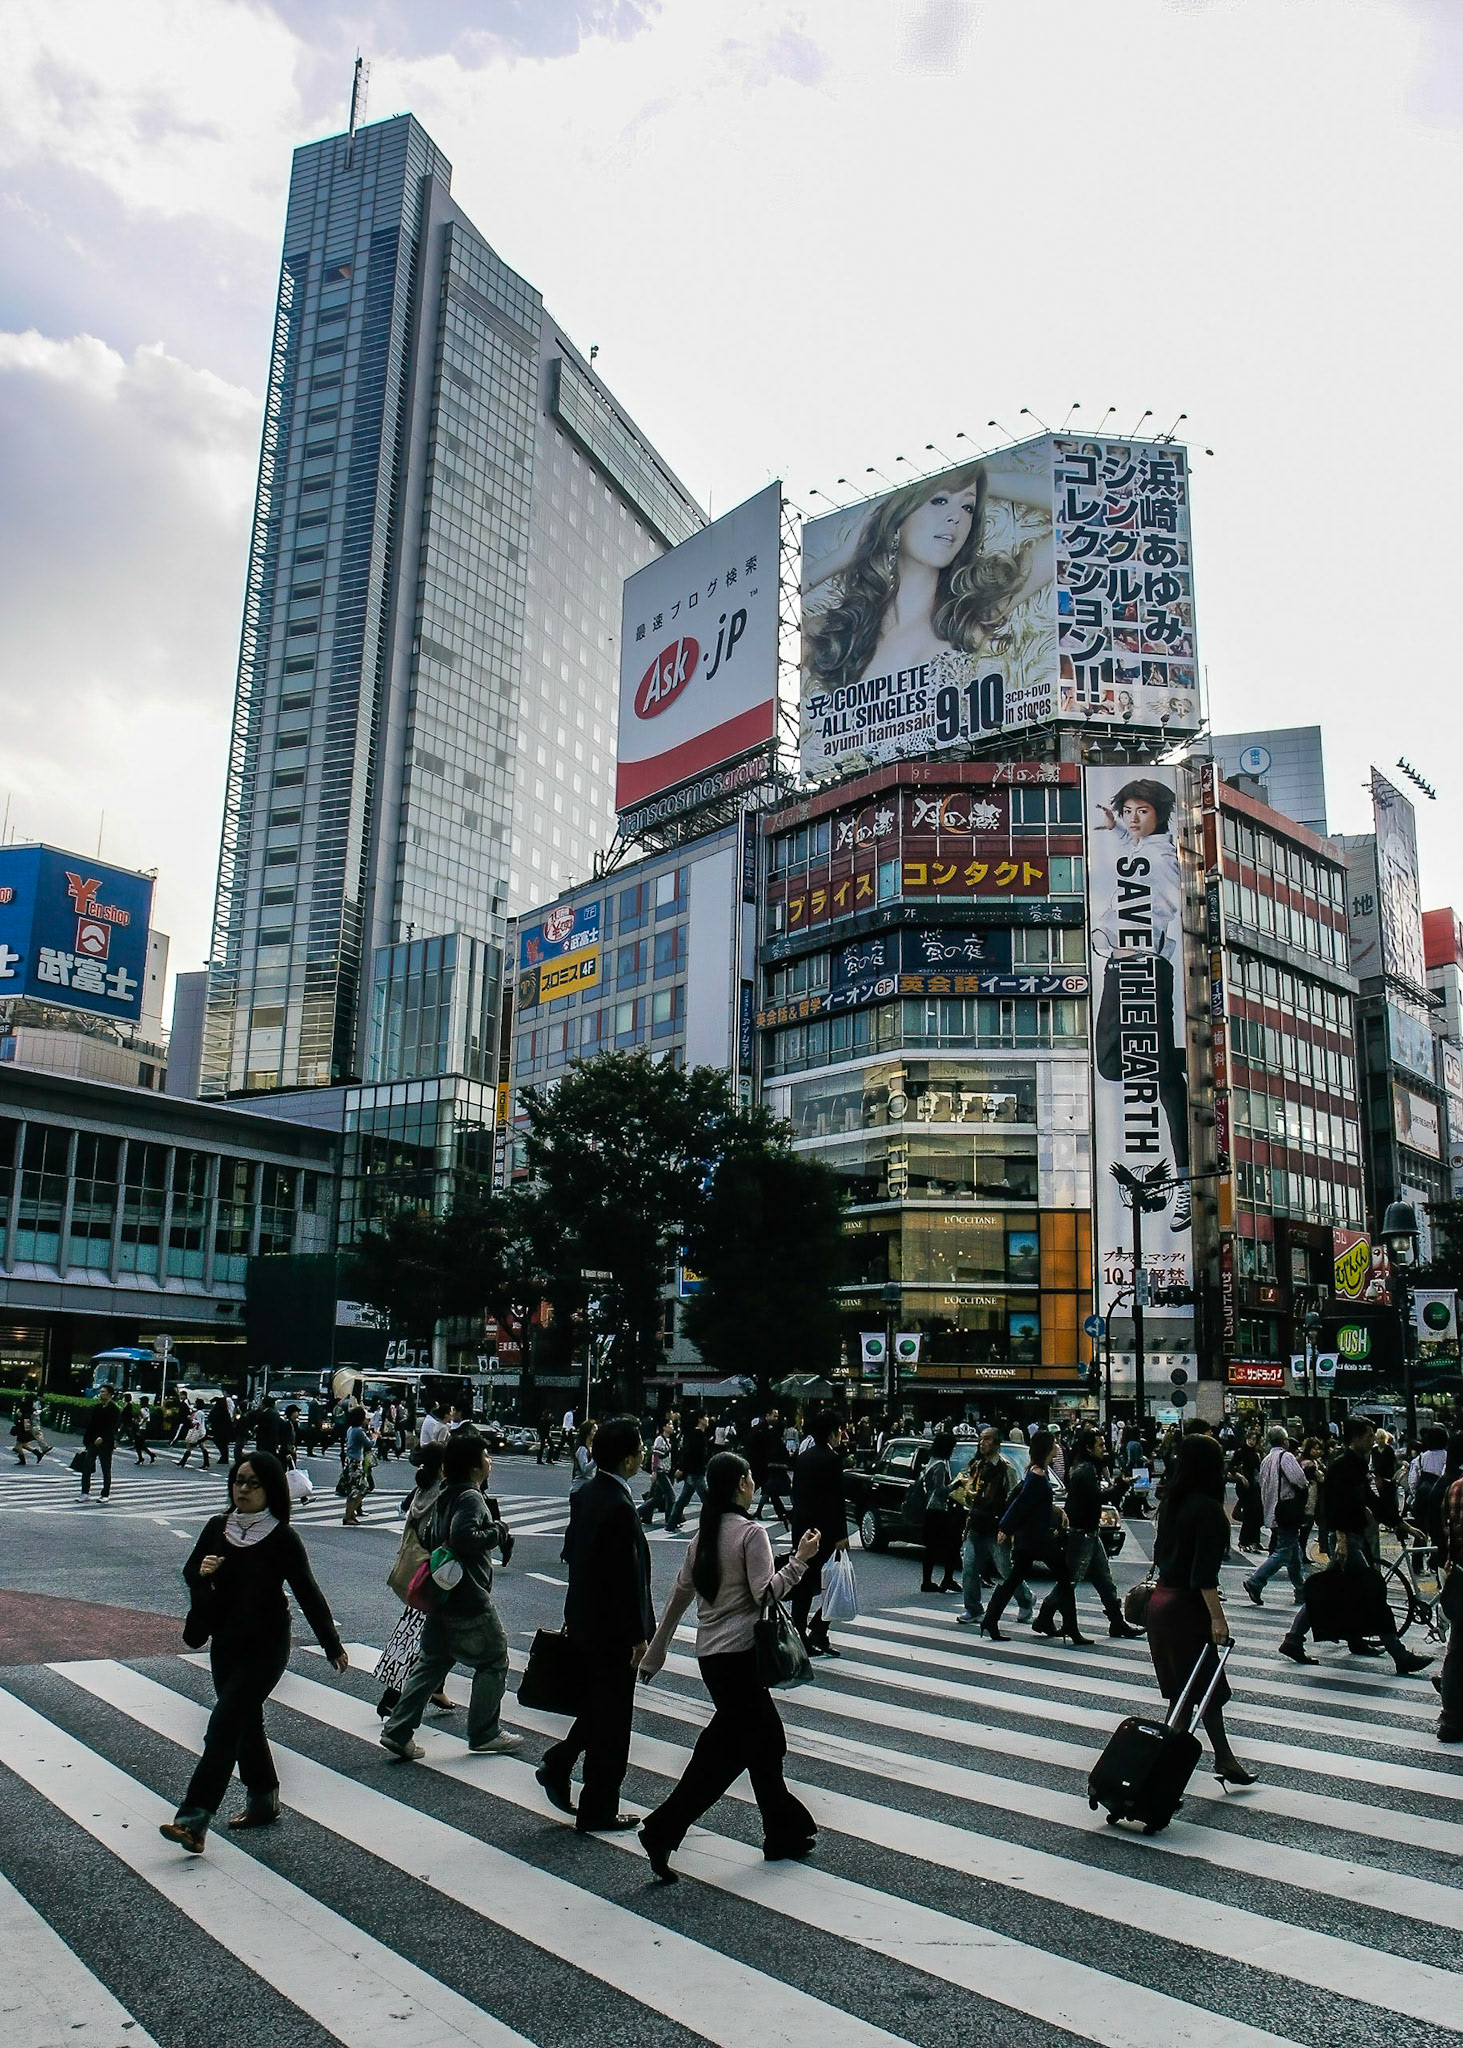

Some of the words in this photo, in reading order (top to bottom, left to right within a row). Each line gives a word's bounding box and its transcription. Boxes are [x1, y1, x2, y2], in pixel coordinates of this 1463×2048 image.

[1102, 456, 1143, 603] シングル
[636, 555, 757, 642] 最速ブログ検索
[833, 663, 930, 712] COMPLETE
[1005, 682, 1050, 704] 3CD+DVD
[1005, 706, 1014, 725] in
[823, 732, 864, 756] ayumi
[868, 710, 936, 743] hamasaki
[904, 860, 1043, 886] コンタクト
[789, 873, 873, 923] プライス
[1116, 855, 1152, 948] SAVE
[104, 905, 130, 926] shop
[904, 909, 916, 918] 7F
[37, 946, 138, 1001] 武富士
[541, 964, 578, 992] プロミス
[582, 960, 594, 976] 4F
[1065, 979, 1084, 991] 6F
[878, 980, 892, 994] 6F
[1119, 957, 1157, 1025] THE
[1121, 1031, 1160, 1154] EARTH
[944, 1215, 997, 1224] L'OCCITANE
[944, 1296, 997, 1305] L'OCCITANE
[1340, 1328, 1367, 1352] LUSH
[975, 1367, 1016, 1376] L'OCCITANE
[1247, 1368, 1276, 1381] サンドラッグ
